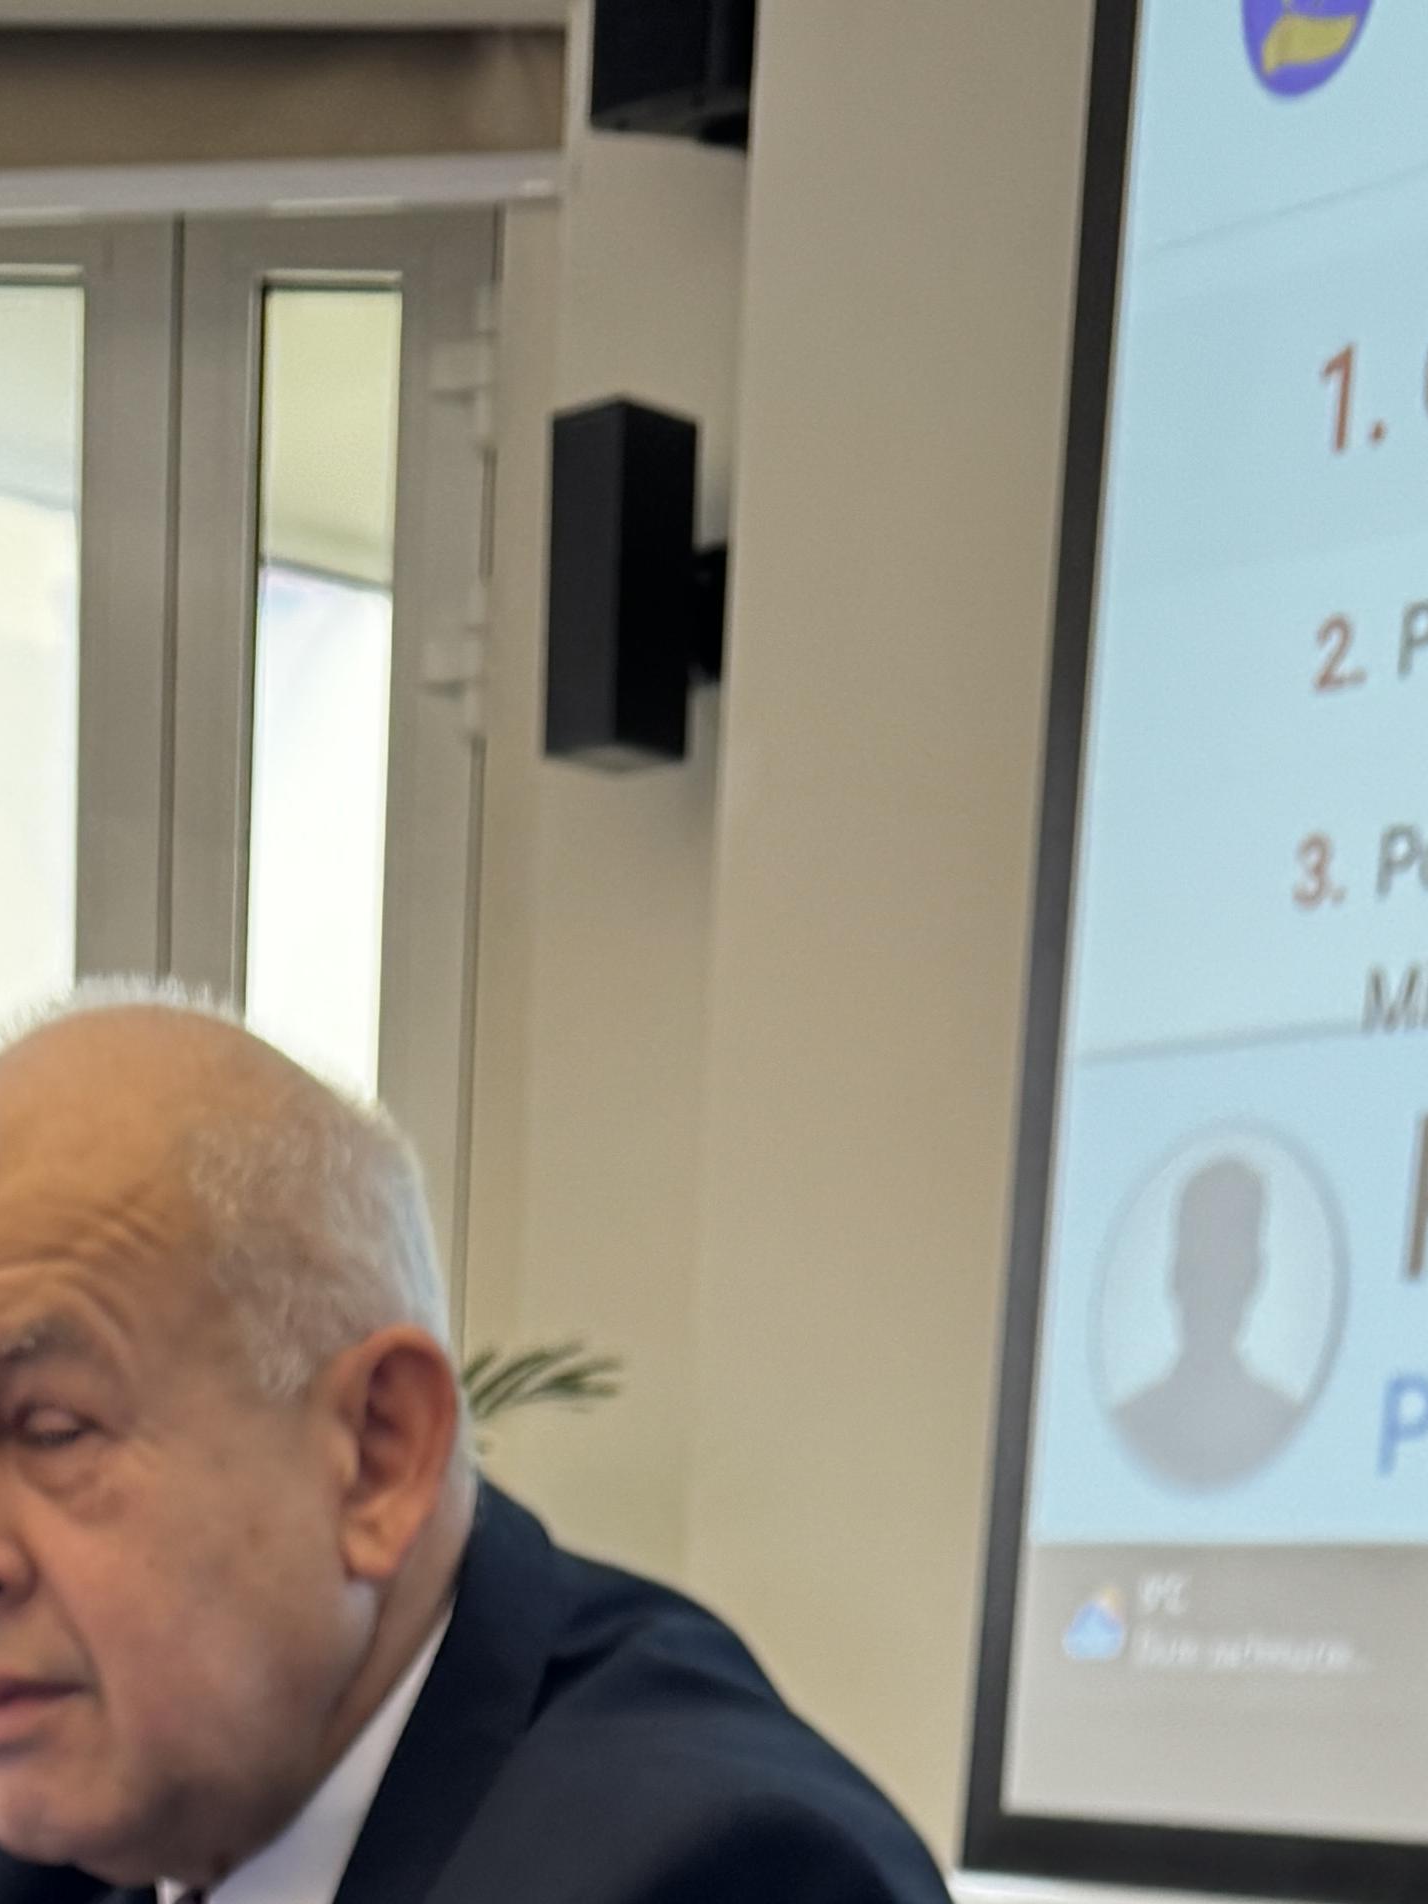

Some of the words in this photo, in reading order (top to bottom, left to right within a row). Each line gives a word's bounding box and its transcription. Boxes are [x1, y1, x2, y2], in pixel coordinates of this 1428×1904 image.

[1320, 342, 1386, 454] 1.
[1312, 612, 1368, 693] 2.
[1292, 831, 1346, 909] 3.
